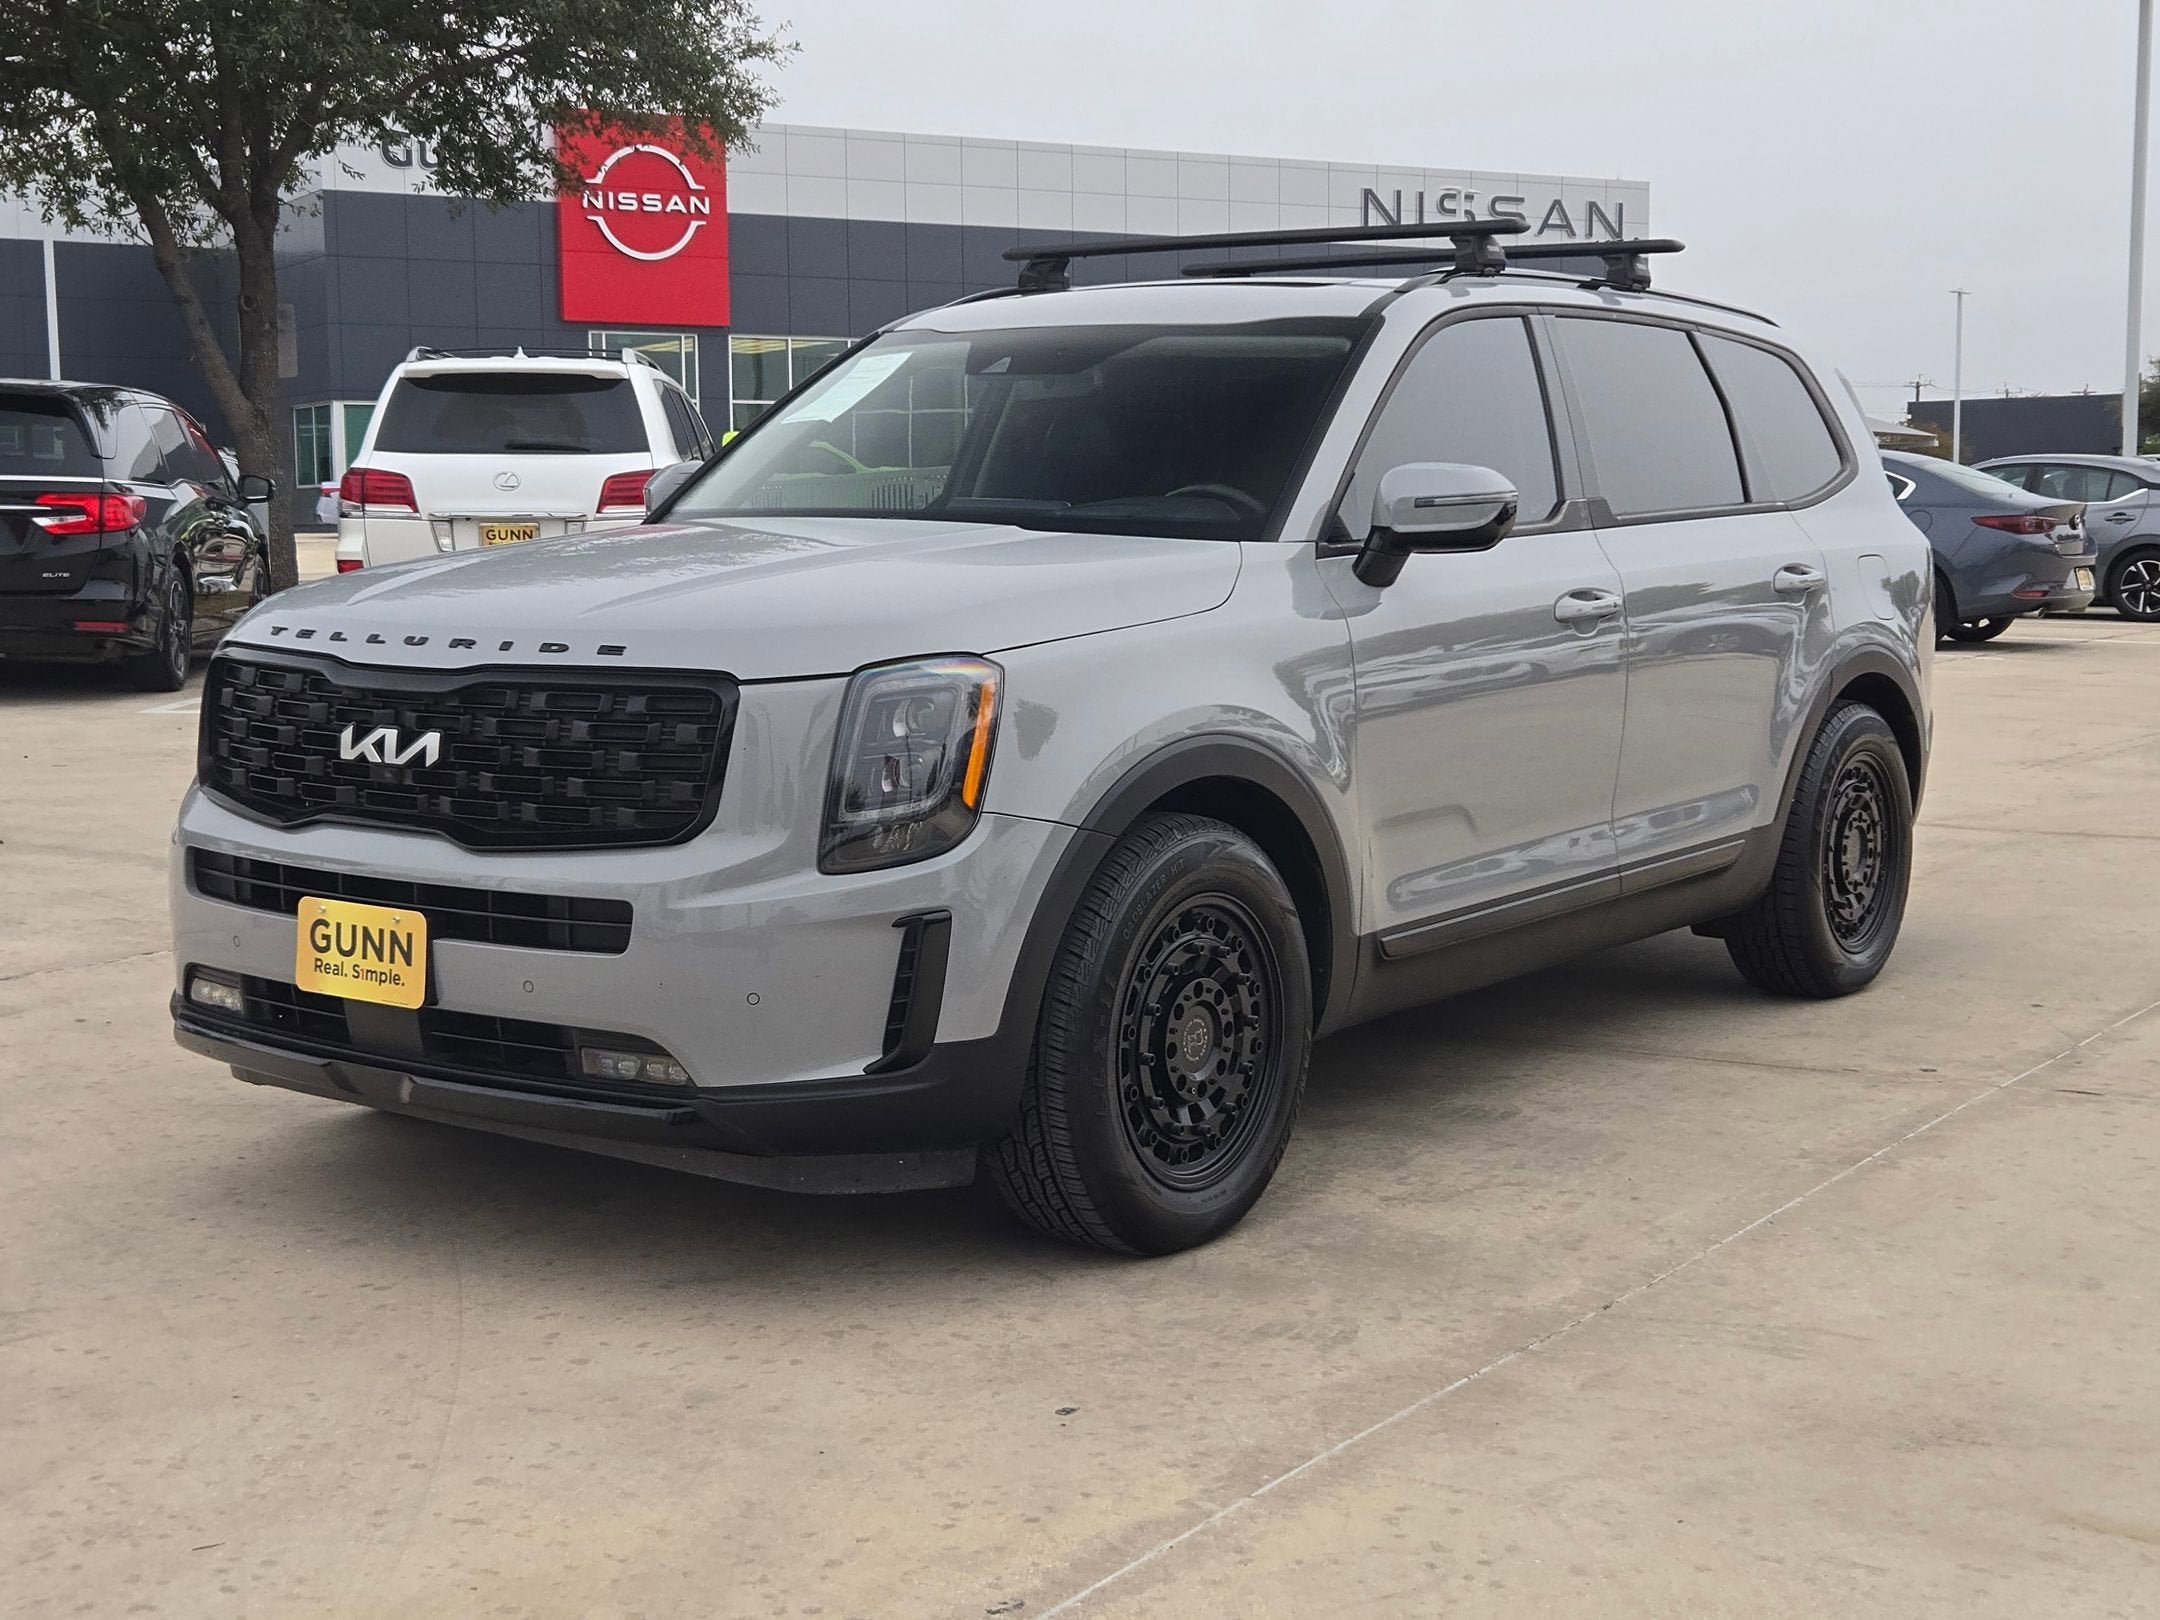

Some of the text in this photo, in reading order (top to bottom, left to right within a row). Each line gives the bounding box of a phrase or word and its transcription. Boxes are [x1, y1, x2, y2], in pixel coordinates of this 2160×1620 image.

[582, 190, 710, 215] NISSAN
[486, 529, 534, 541] GUNN
[270, 625, 628, 656] TELLURIDE
[309, 917, 413, 967] GUNN
[314, 957, 348, 978] Real.
